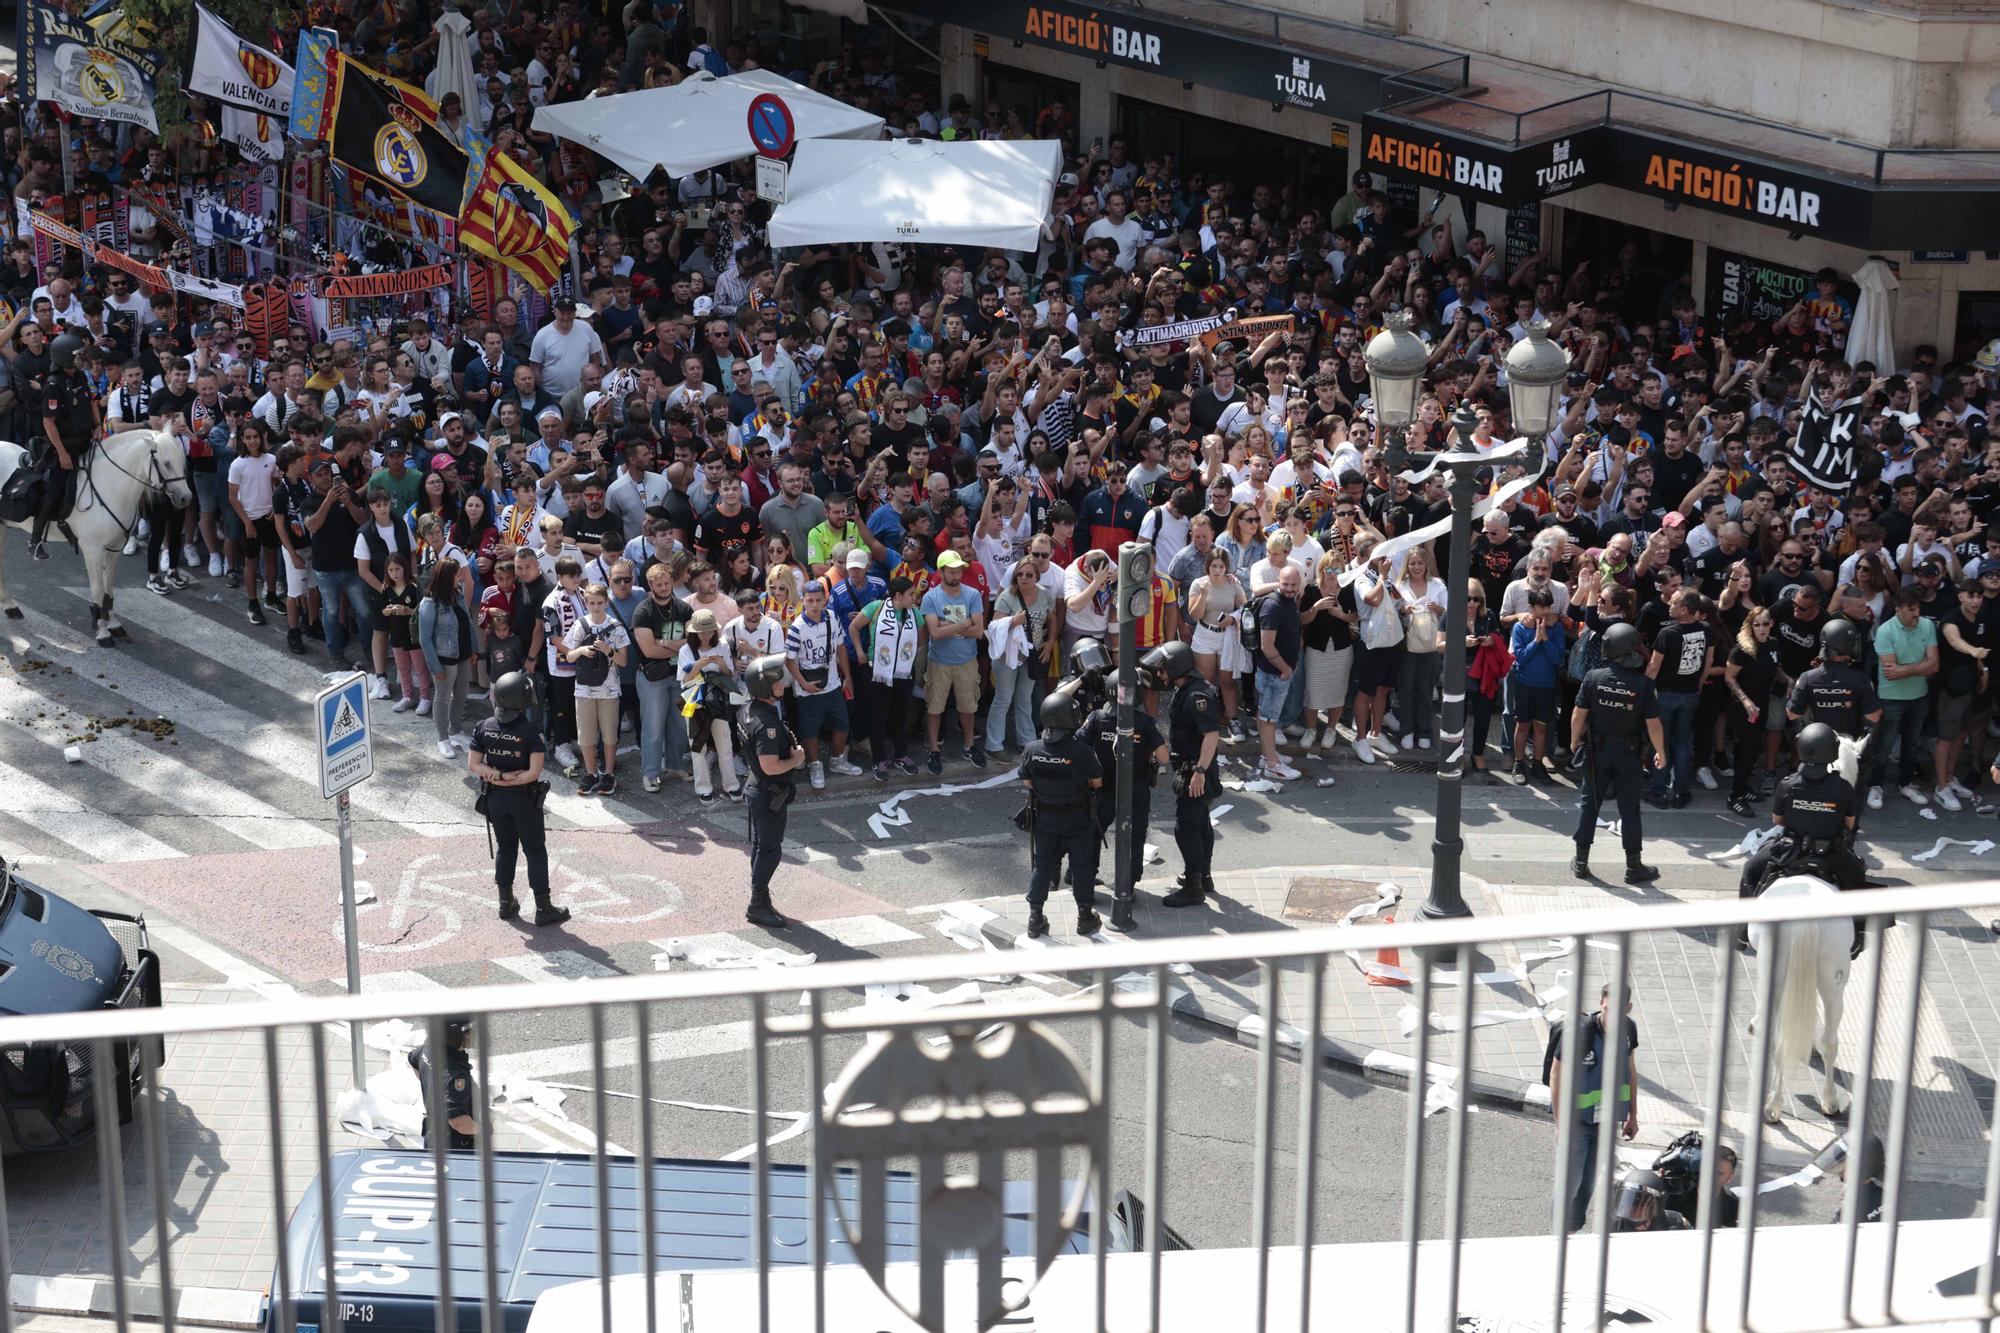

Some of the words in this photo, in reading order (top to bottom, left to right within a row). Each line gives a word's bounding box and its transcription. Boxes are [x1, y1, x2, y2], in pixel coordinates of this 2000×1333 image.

[1113, 26, 1161, 65] BAR
[223, 81, 276, 110] VALENCIA
[1274, 73, 1327, 102] TURIA
[74, 102, 109, 118] Santiago
[110, 107, 149, 126] Bernabeu
[238, 135, 271, 163] LENCIA
[1454, 155, 1503, 194] BAR
[1536, 158, 1586, 187] TURIA
[1757, 180, 1820, 227] BAR
[1926, 251, 1955, 259] SUECIA
[332, 267, 446, 296] ANTIMADRIDISTA
[1722, 261, 1740, 305] BAR
[1756, 267, 1804, 293] MOJITO
[1754, 295, 1783, 320] Agua
[1137, 318, 1223, 343] ANTIMADRIDISTA
[1215, 320, 1289, 340] ANTIMADRIDISTA
[802, 639, 814, 650] 10
[328, 751, 366, 776] PREFERENCIA
[334, 763, 361, 782] CICLISTA
[1032, 755, 1068, 765] POLICIA
[1792, 804, 1836, 812] NACIONAL
